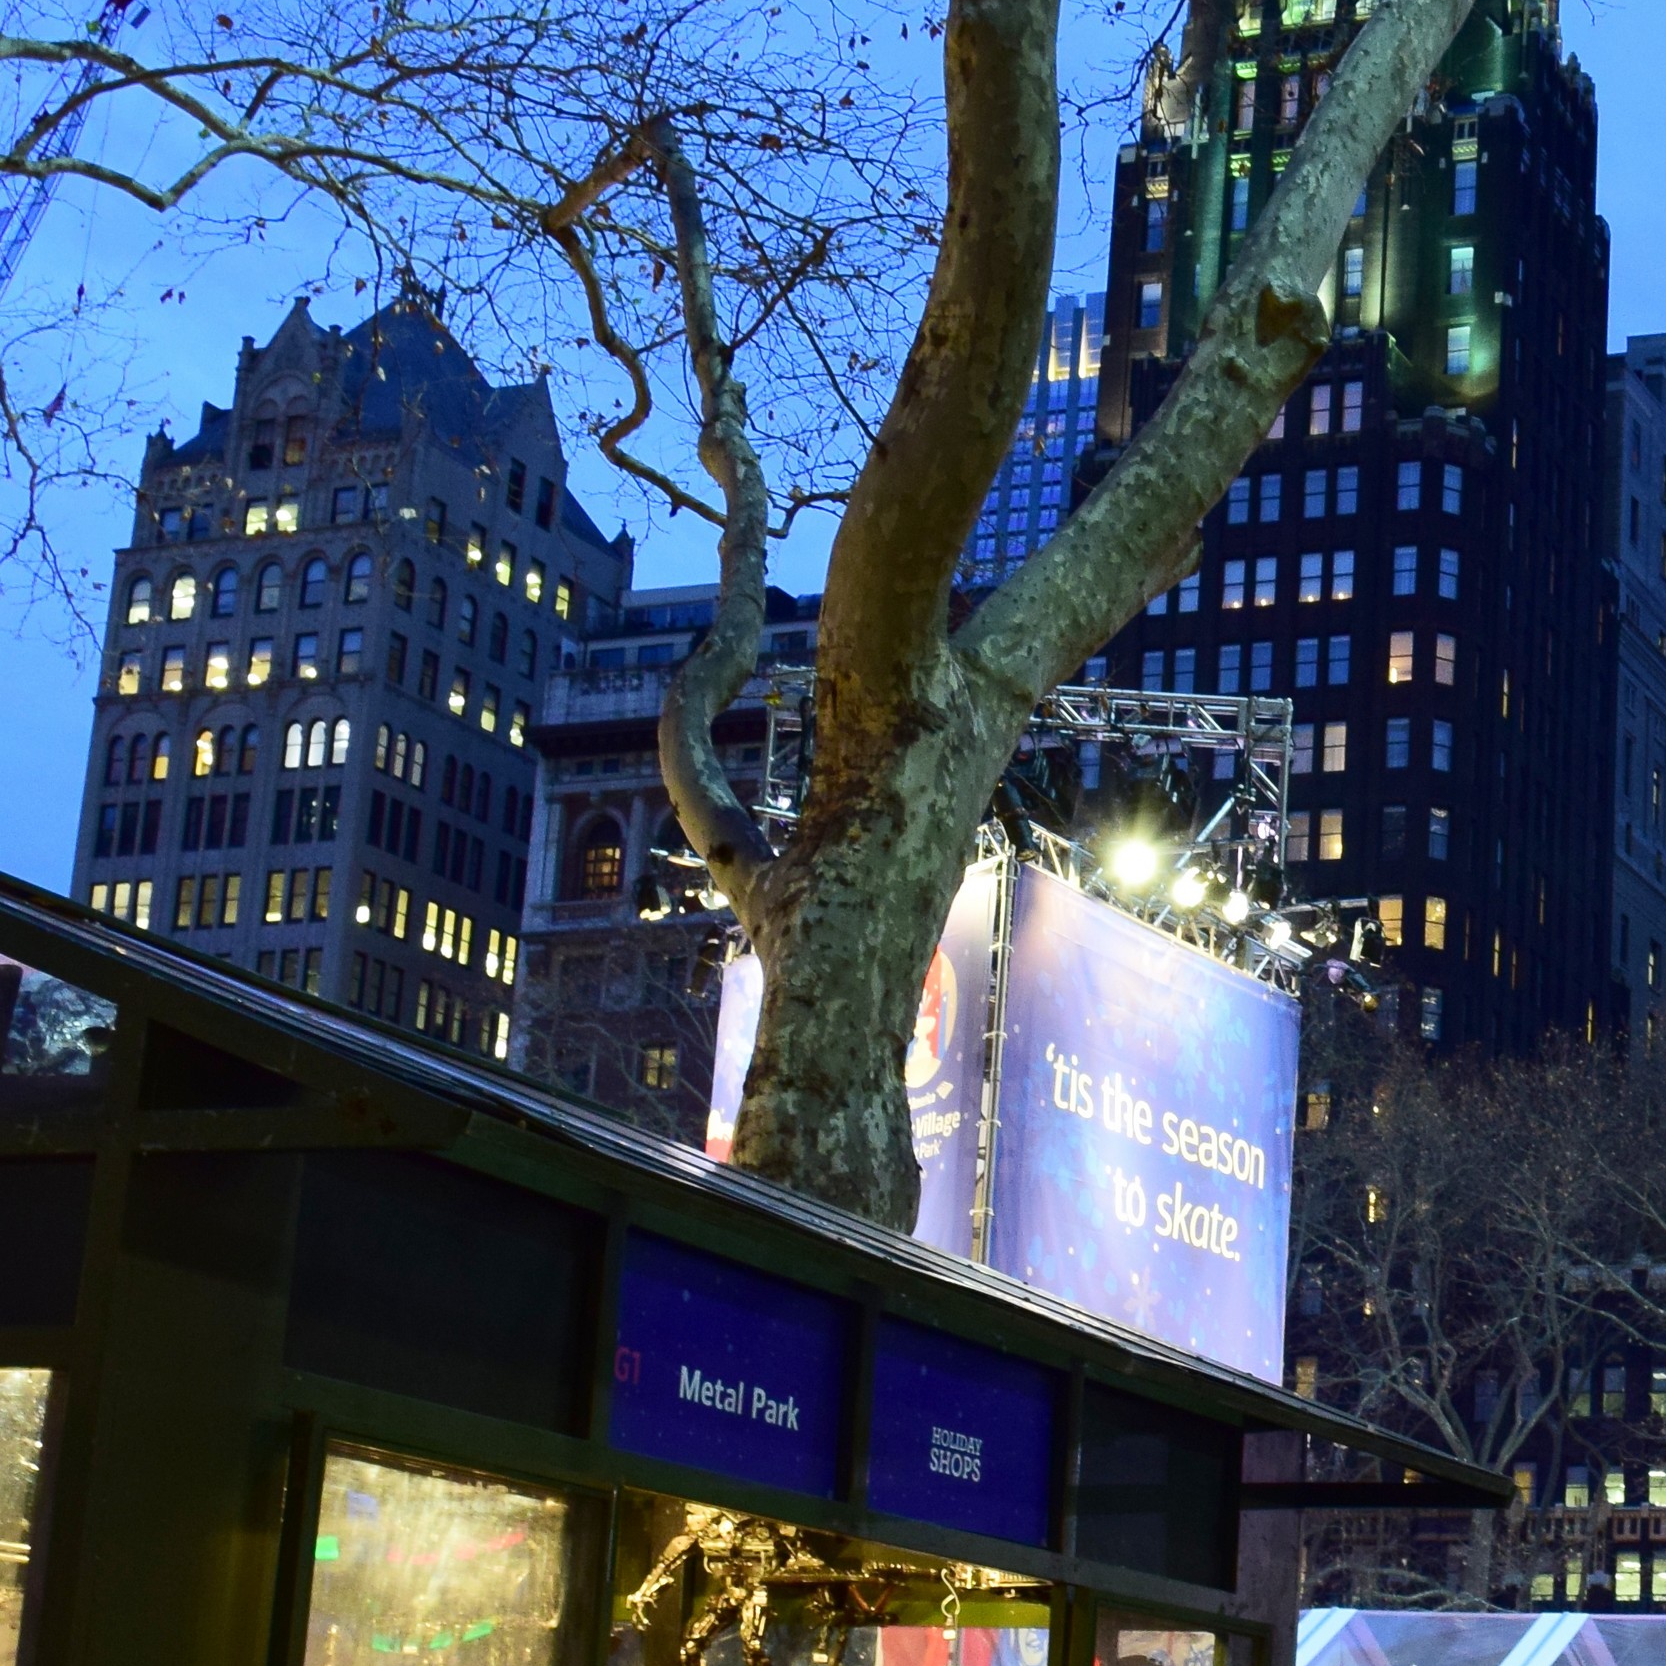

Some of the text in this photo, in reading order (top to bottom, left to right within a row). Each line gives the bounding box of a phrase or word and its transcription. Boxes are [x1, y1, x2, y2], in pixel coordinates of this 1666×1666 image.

[915, 1111, 961, 1139] Village
[1101, 1072, 1153, 1145] the
[1161, 1111, 1265, 1190] season
[1112, 1166, 1240, 1262] to skate.
[613, 1346, 642, 1385] G1
[679, 1364, 800, 1432] Metal Park
[931, 1426, 983, 1456] HOLIDAY
[928, 1448, 982, 1483] SHOPS
